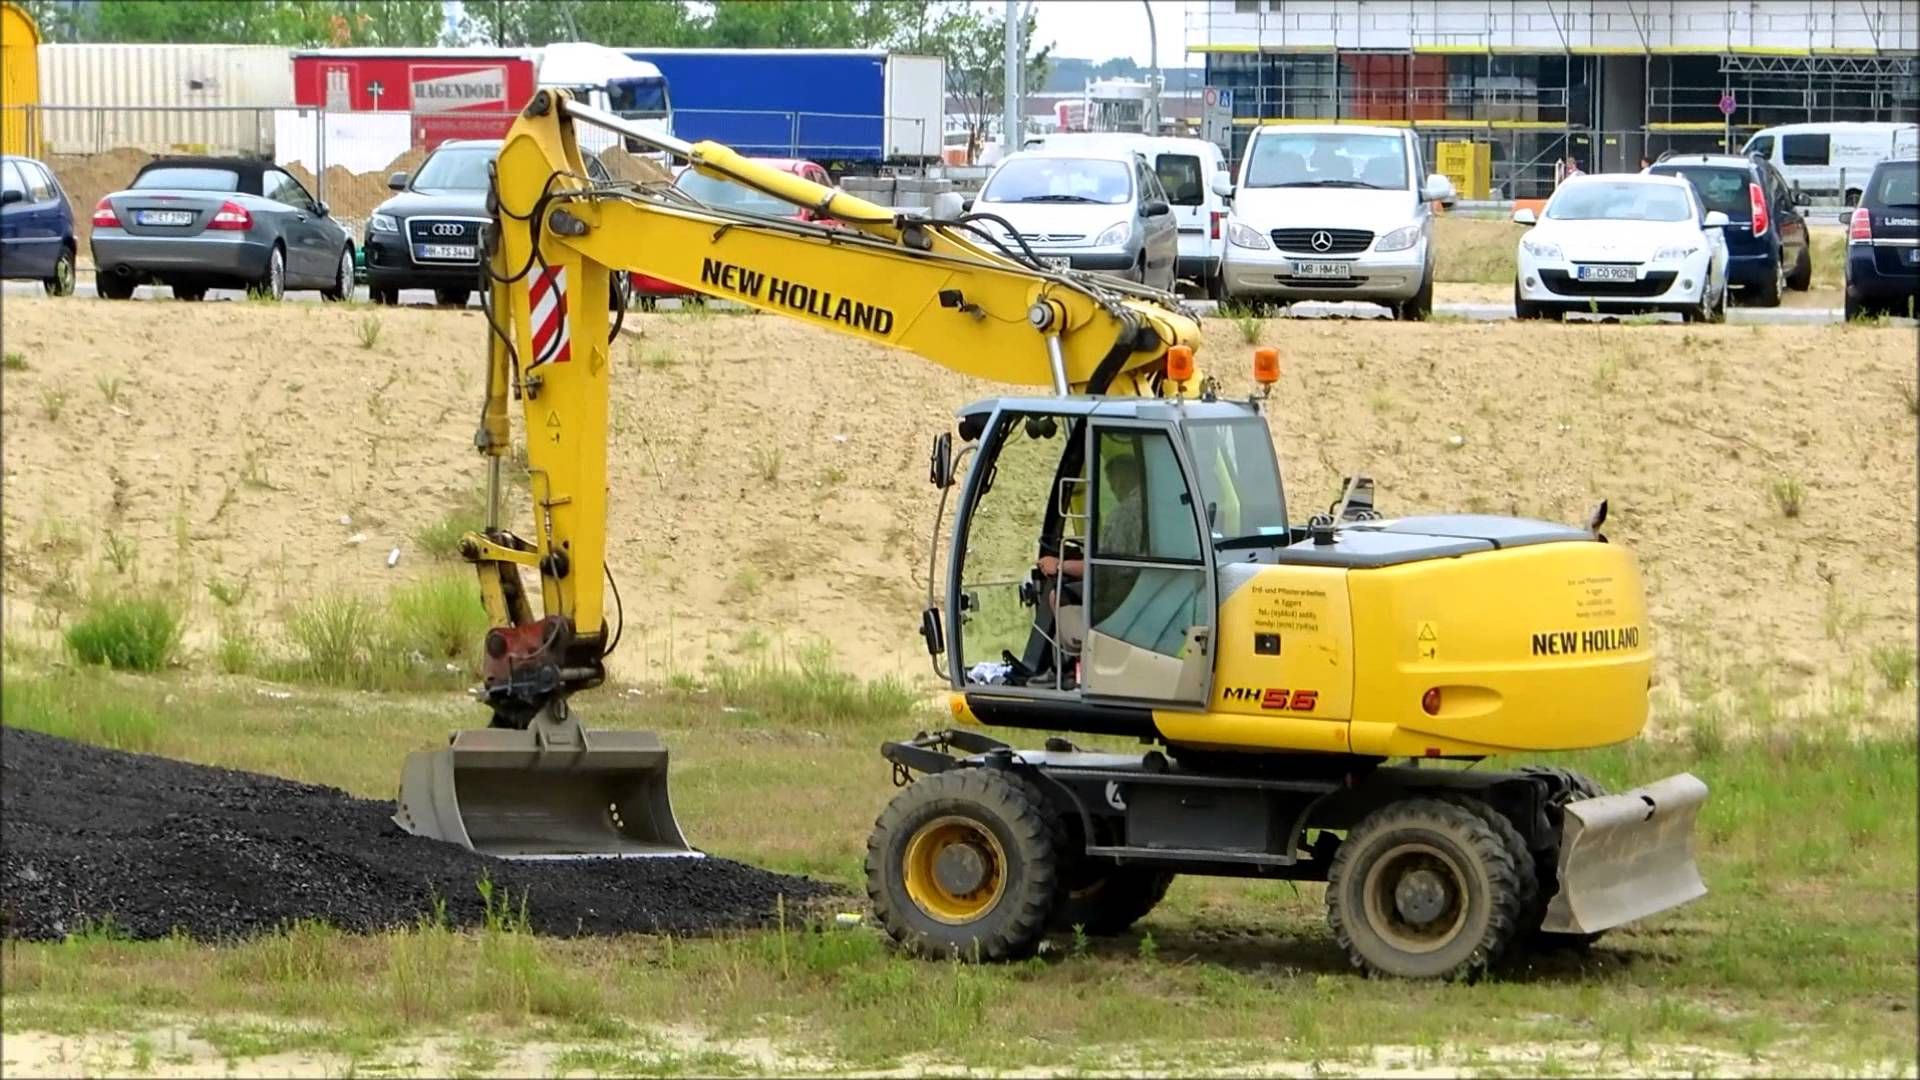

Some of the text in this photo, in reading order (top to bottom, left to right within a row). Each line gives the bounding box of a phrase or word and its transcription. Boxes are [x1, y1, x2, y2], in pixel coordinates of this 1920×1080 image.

[414, 83, 503, 99] HAGENDORF
[701, 257, 895, 335] NEW HOLLAND
[1532, 626, 1639, 656] NEW HOLLAND
[1223, 686, 1319, 711] MH 5.6
